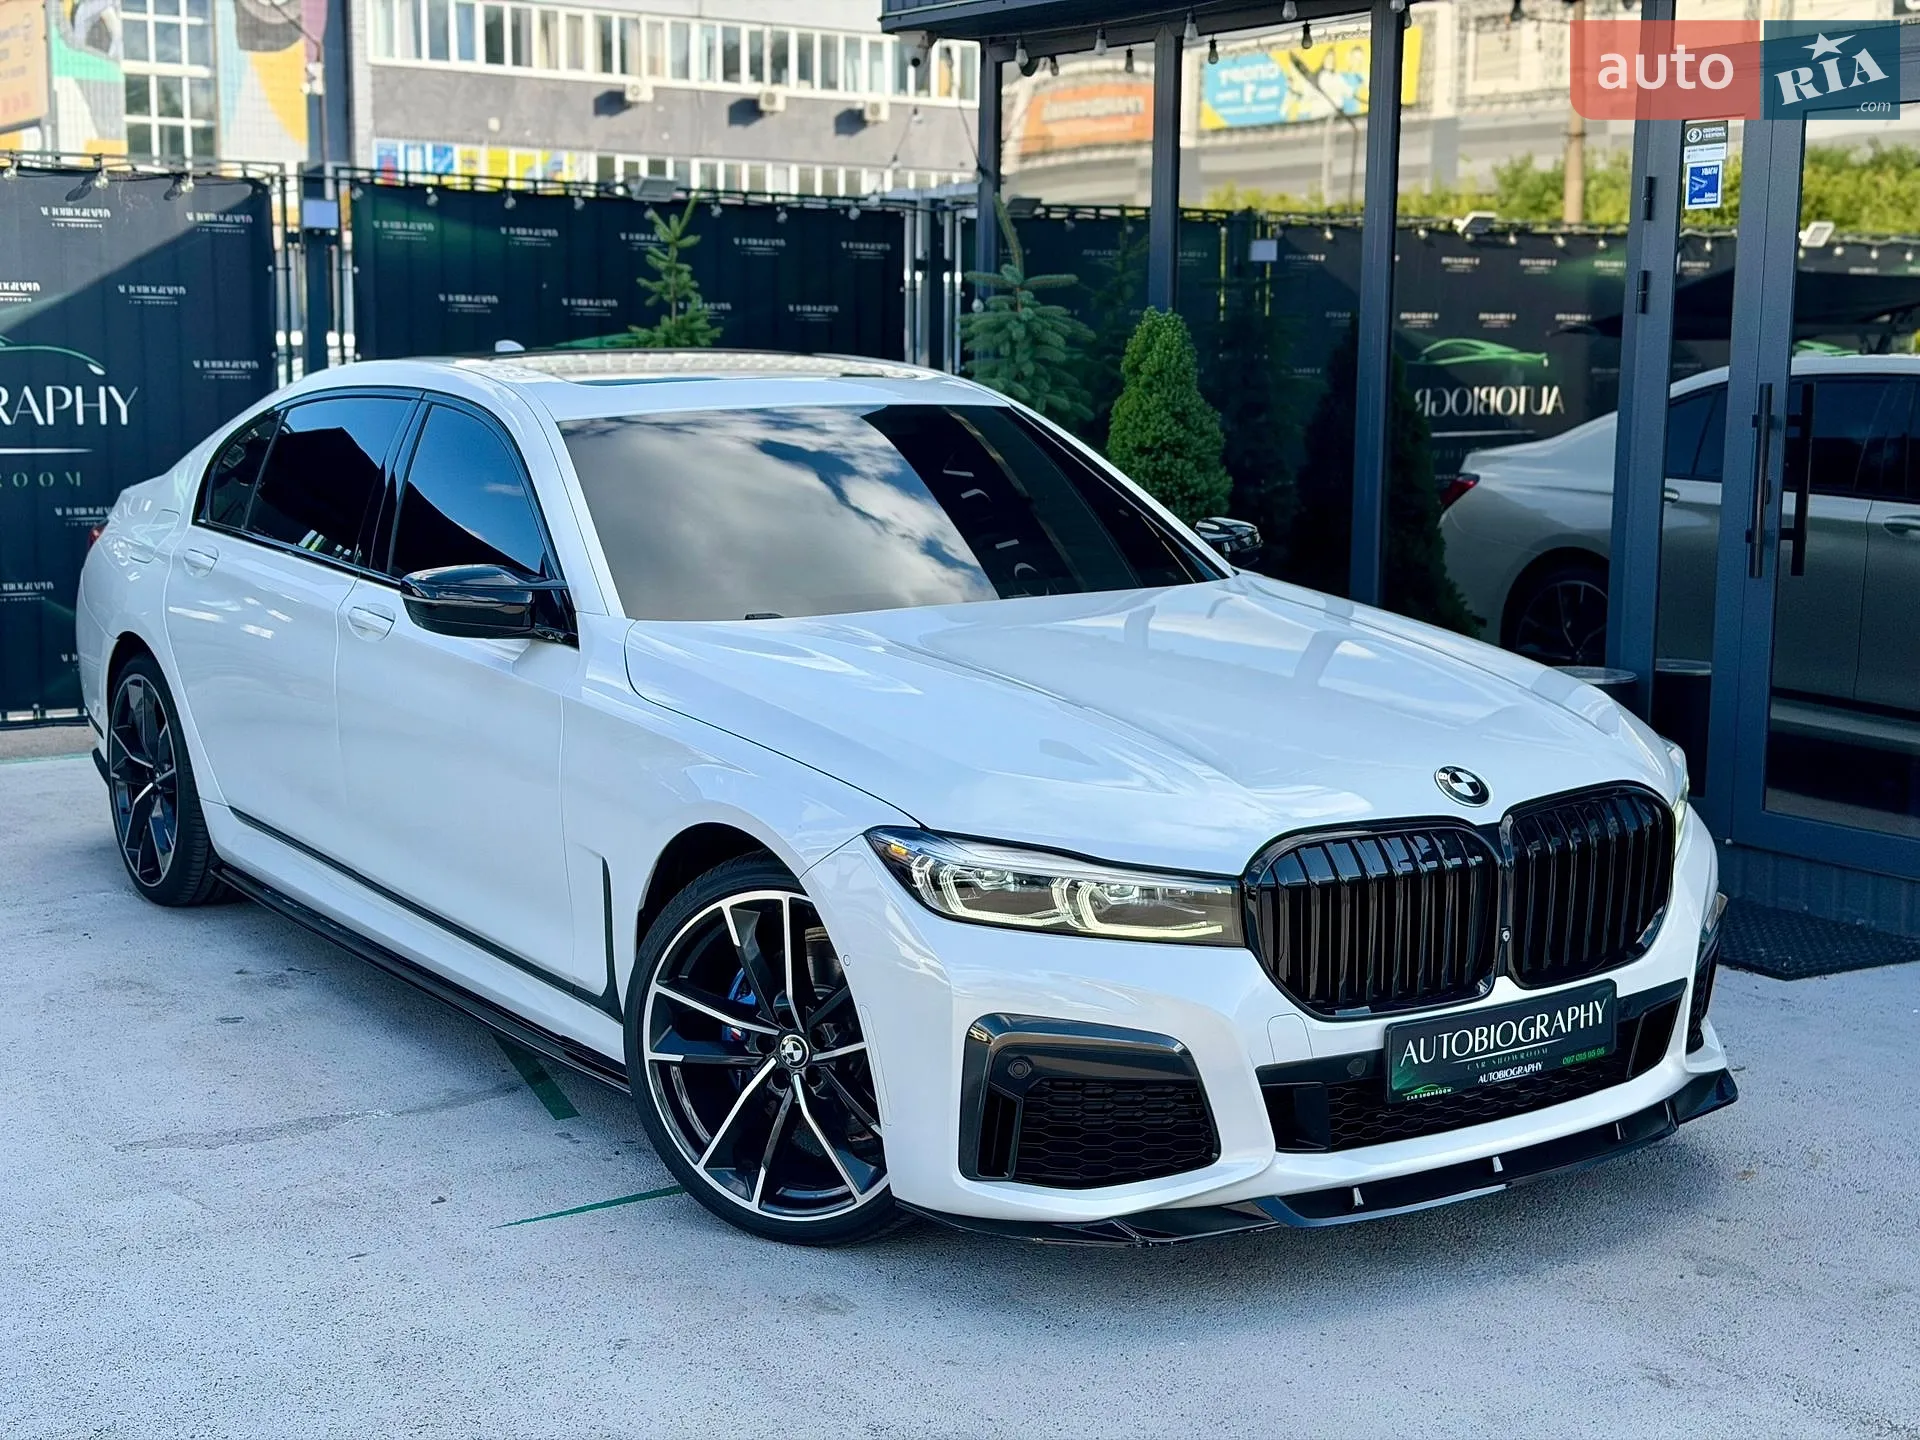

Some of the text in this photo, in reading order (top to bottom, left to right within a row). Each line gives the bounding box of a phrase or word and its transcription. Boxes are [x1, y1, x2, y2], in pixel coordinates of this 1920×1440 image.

[0, 471, 82, 488] OOM
[1400, 998, 1608, 1067] AUTOBIOGRAPHY
[1477, 1061, 1544, 1084] AUTOBIOGRAPHY
